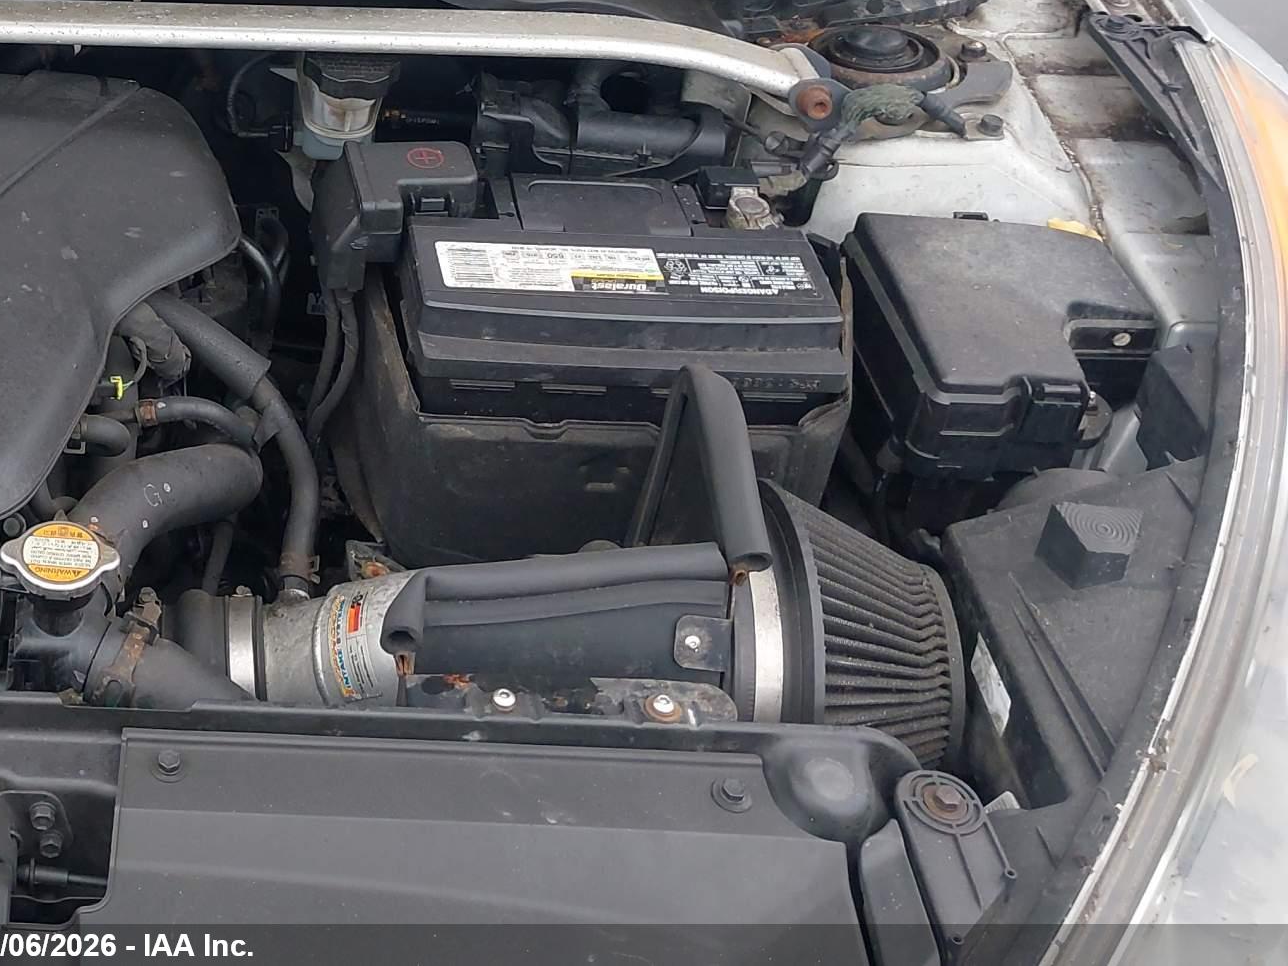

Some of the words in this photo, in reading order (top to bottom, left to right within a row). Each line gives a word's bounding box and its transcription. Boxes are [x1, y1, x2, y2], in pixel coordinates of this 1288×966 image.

[592, 282, 648, 291] Duralast
[34, 566, 72, 575] WARNING
[337, 649, 351, 689] INTAKE
